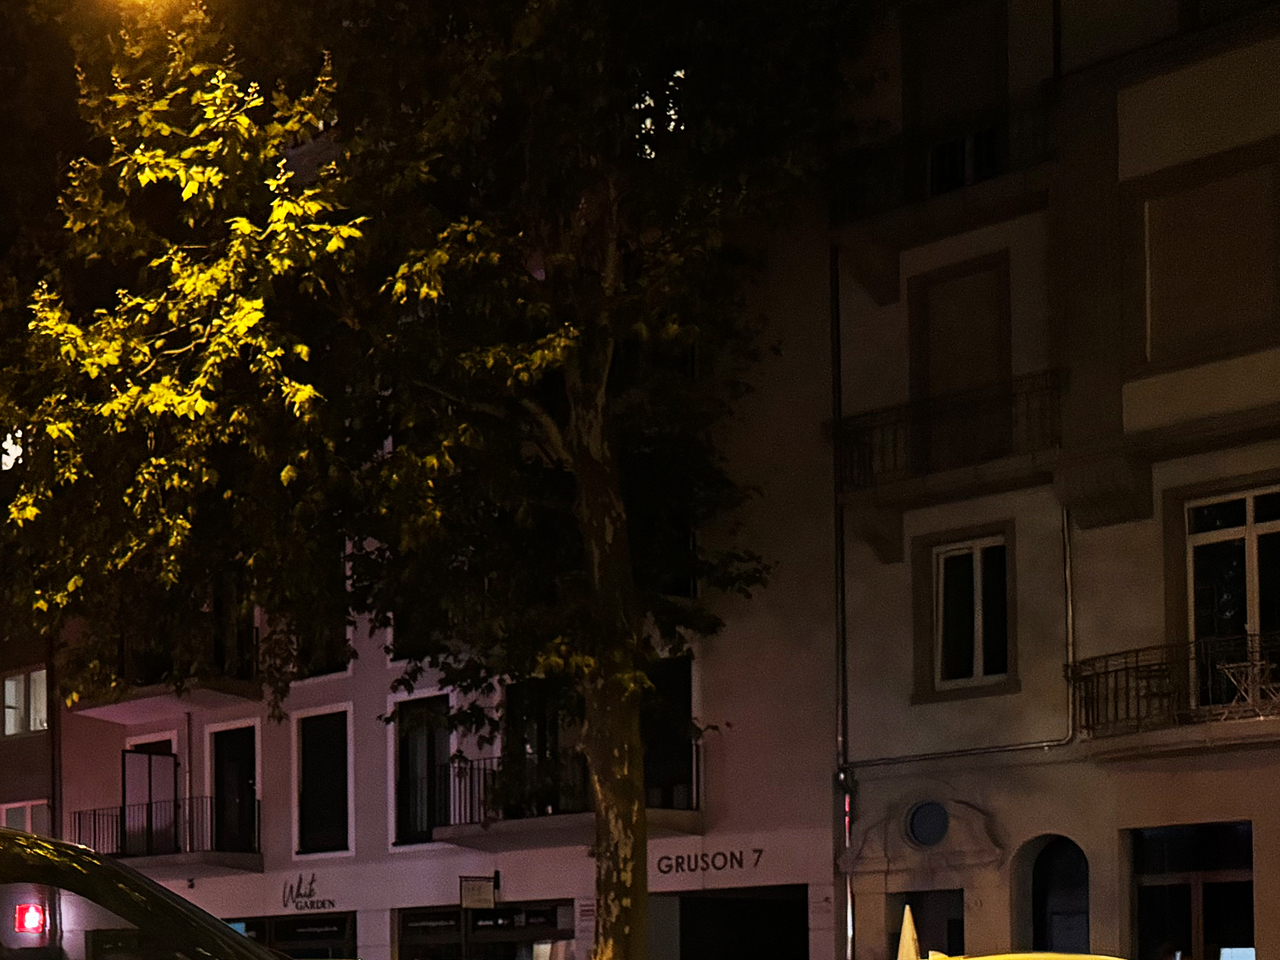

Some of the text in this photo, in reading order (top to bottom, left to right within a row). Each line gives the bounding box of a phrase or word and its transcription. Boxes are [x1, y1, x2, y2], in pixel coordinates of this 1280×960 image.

[657, 849, 763, 874] GRUSON 7
[295, 899, 336, 910] GARDEN
